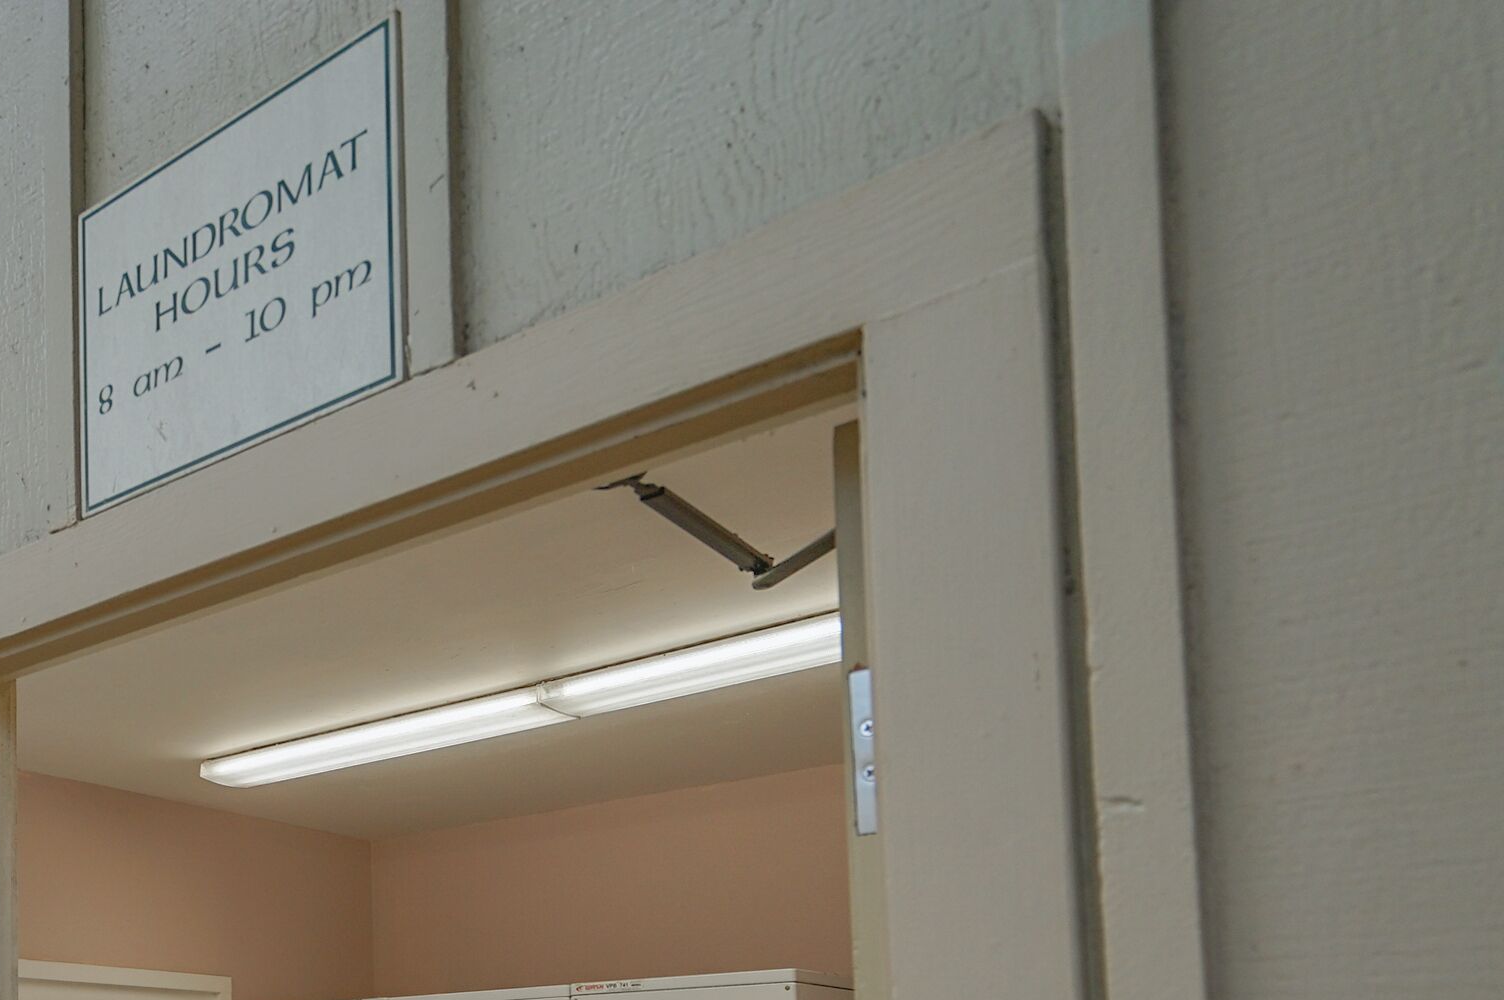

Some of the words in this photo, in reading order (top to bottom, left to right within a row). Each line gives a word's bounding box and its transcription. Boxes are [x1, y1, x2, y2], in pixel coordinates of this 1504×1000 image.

[98, 129, 368, 318] LAUNDROMAT
[154, 227, 297, 333] HOURS
[98, 383, 114, 416] 8
[132, 355, 184, 397] am
[243, 296, 287, 344] 10
[310, 259, 373, 318] pm
